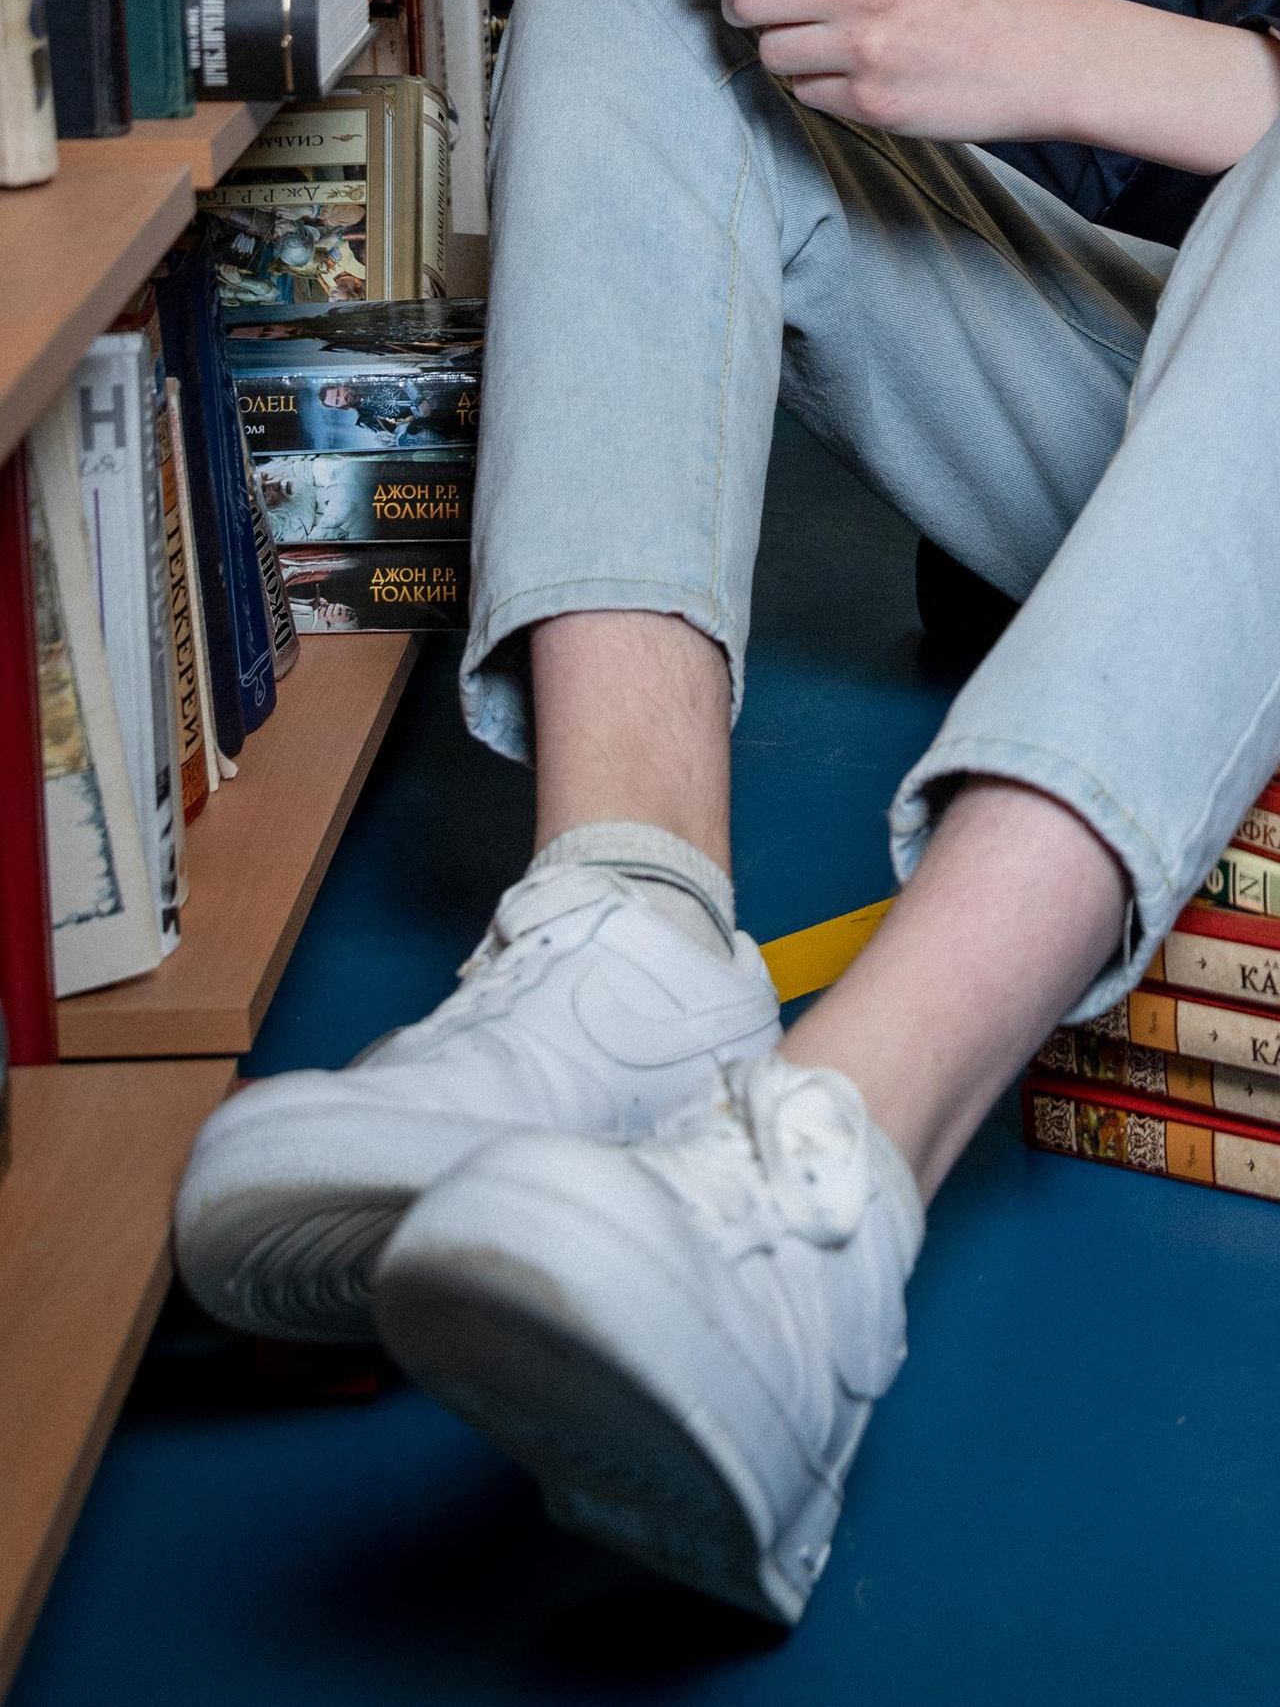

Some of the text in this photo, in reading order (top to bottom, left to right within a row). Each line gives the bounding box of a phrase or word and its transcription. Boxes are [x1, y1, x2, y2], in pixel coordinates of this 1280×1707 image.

[237, 189, 252, 205] Р.
[259, 188, 274, 204] Р.
[373, 484, 429, 501] ДЖОН
[372, 502, 460, 520] ТОЛКИН
[371, 567, 427, 585] ДЖОН
[369, 585, 457, 603] ТОЛКИН
